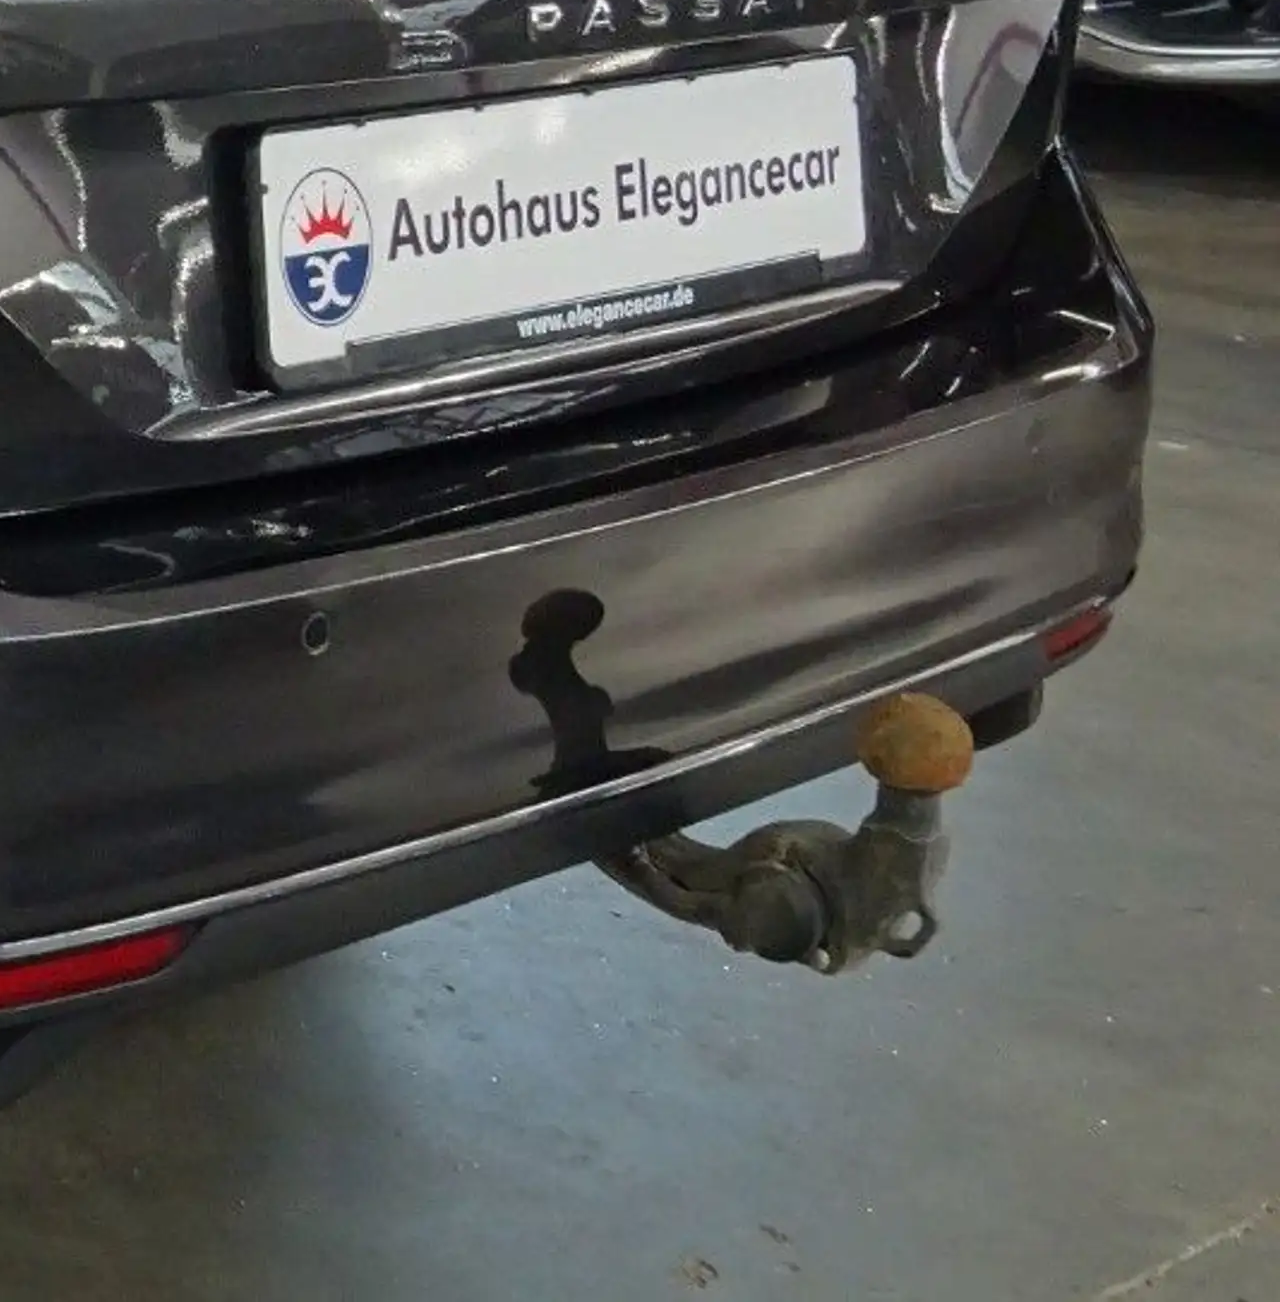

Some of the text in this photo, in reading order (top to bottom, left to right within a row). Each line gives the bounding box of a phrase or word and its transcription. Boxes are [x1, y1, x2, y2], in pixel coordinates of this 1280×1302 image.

[387, 145, 840, 261] Autohaus Elegancecar
[516, 284, 695, 339] www.elegancecar.de
